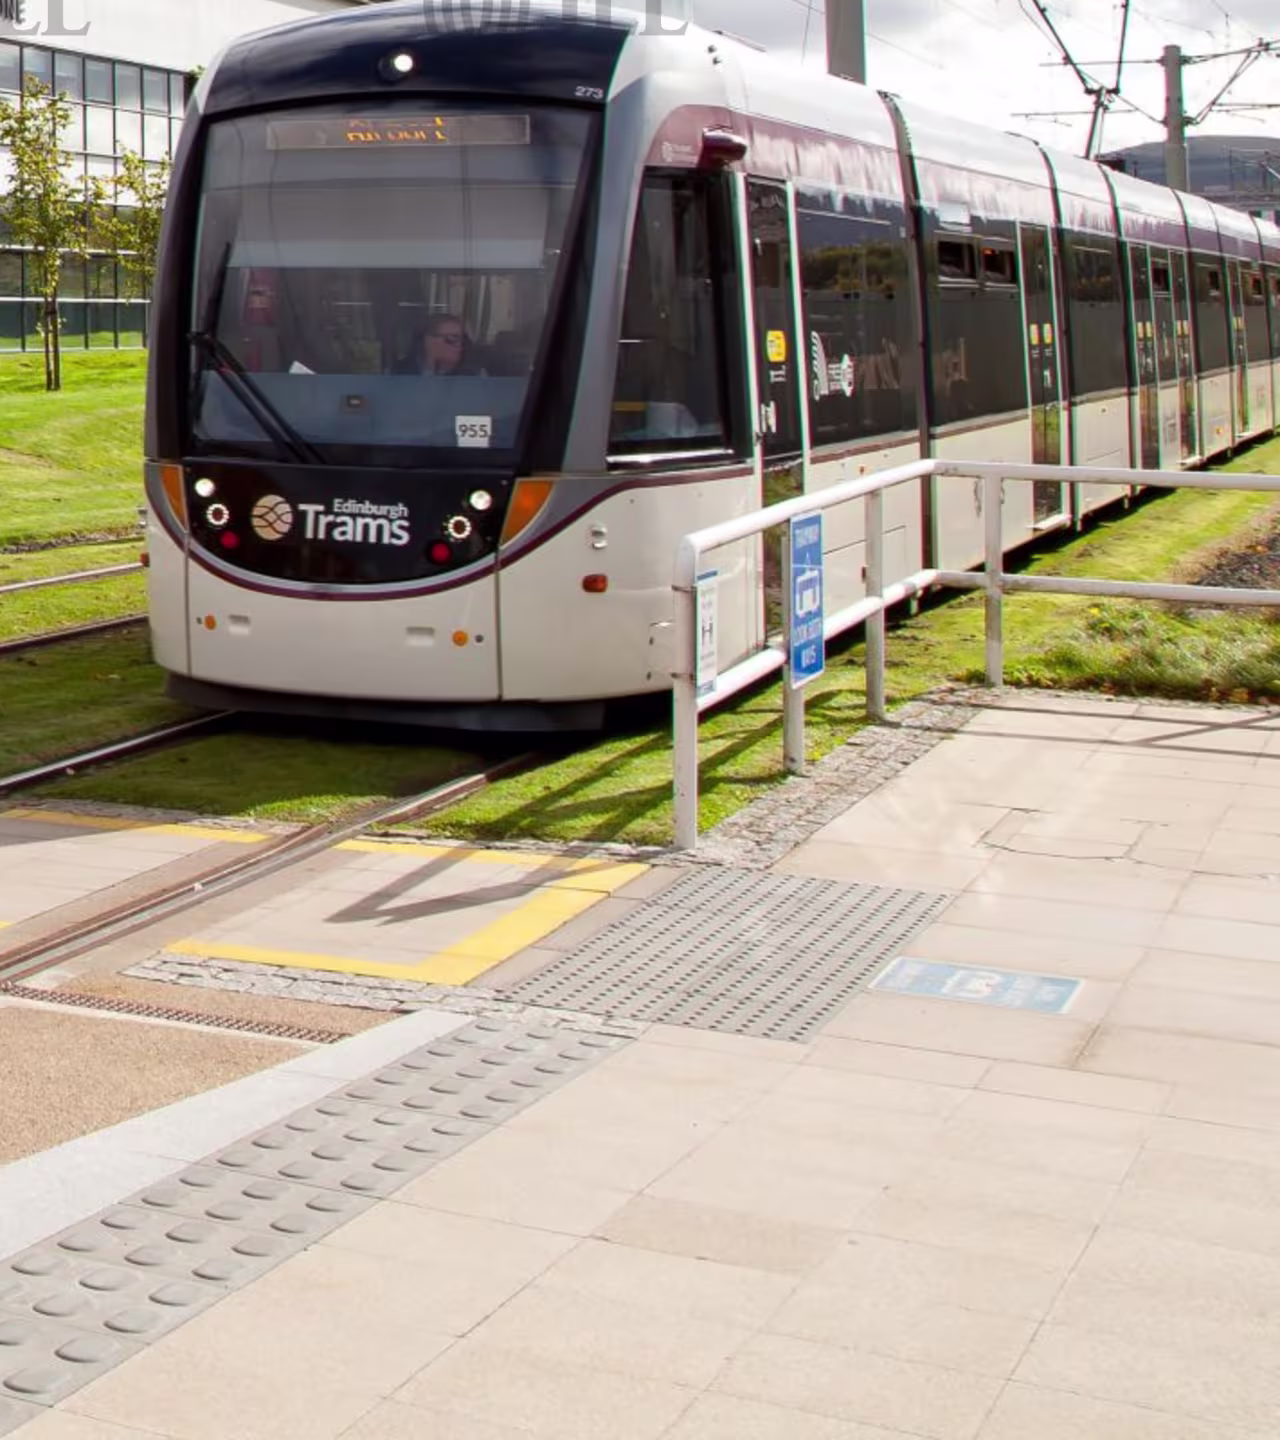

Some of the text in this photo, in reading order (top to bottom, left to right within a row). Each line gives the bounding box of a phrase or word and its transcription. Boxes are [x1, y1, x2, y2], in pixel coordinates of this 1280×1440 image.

[458, 424, 489, 439] 955
[333, 497, 409, 519] Edinburgh
[298, 503, 410, 546] Trams
